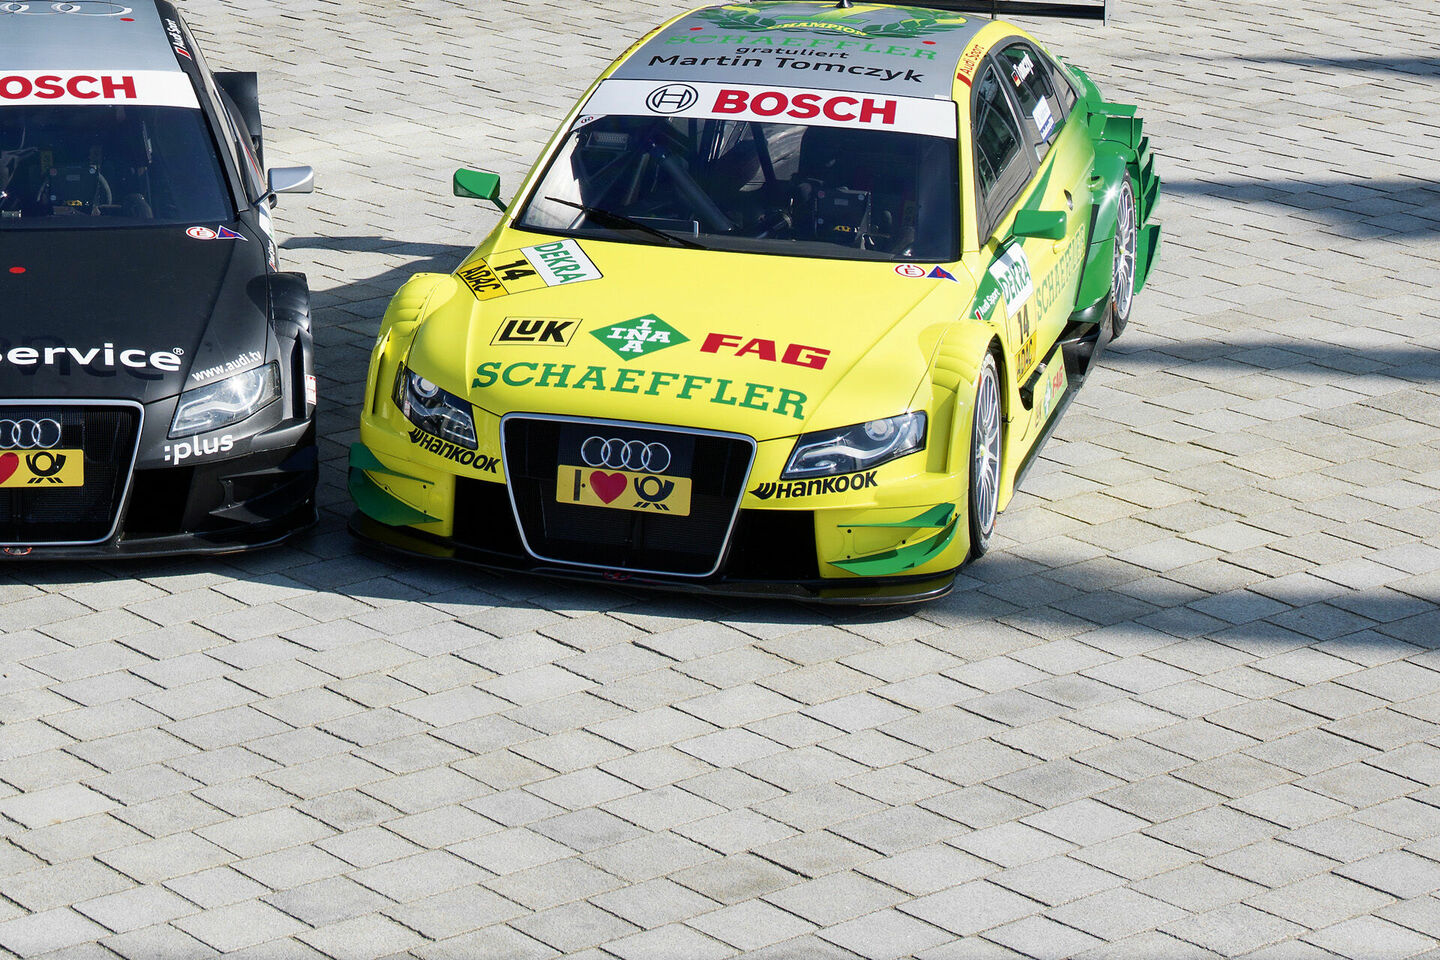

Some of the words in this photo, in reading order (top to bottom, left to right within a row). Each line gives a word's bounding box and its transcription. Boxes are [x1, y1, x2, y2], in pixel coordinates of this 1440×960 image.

[767, 21, 869, 38] CHAMPION
[664, 33, 937, 61] SCHAEFFLER
[736, 45, 850, 60] gratuliert
[648, 54, 762, 70] Martin
[774, 56, 925, 84] Tomczyk
[712, 89, 897, 125] BOSCH
[460, 262, 502, 294] ADAC
[493, 258, 538, 282] 14
[533, 241, 588, 285] DEKRA
[997, 256, 1032, 304] DEKRA
[191, 347, 262, 382] www.audi.tv
[700, 332, 831, 370] FAG
[472, 361, 808, 420] SCHAEFFLER
